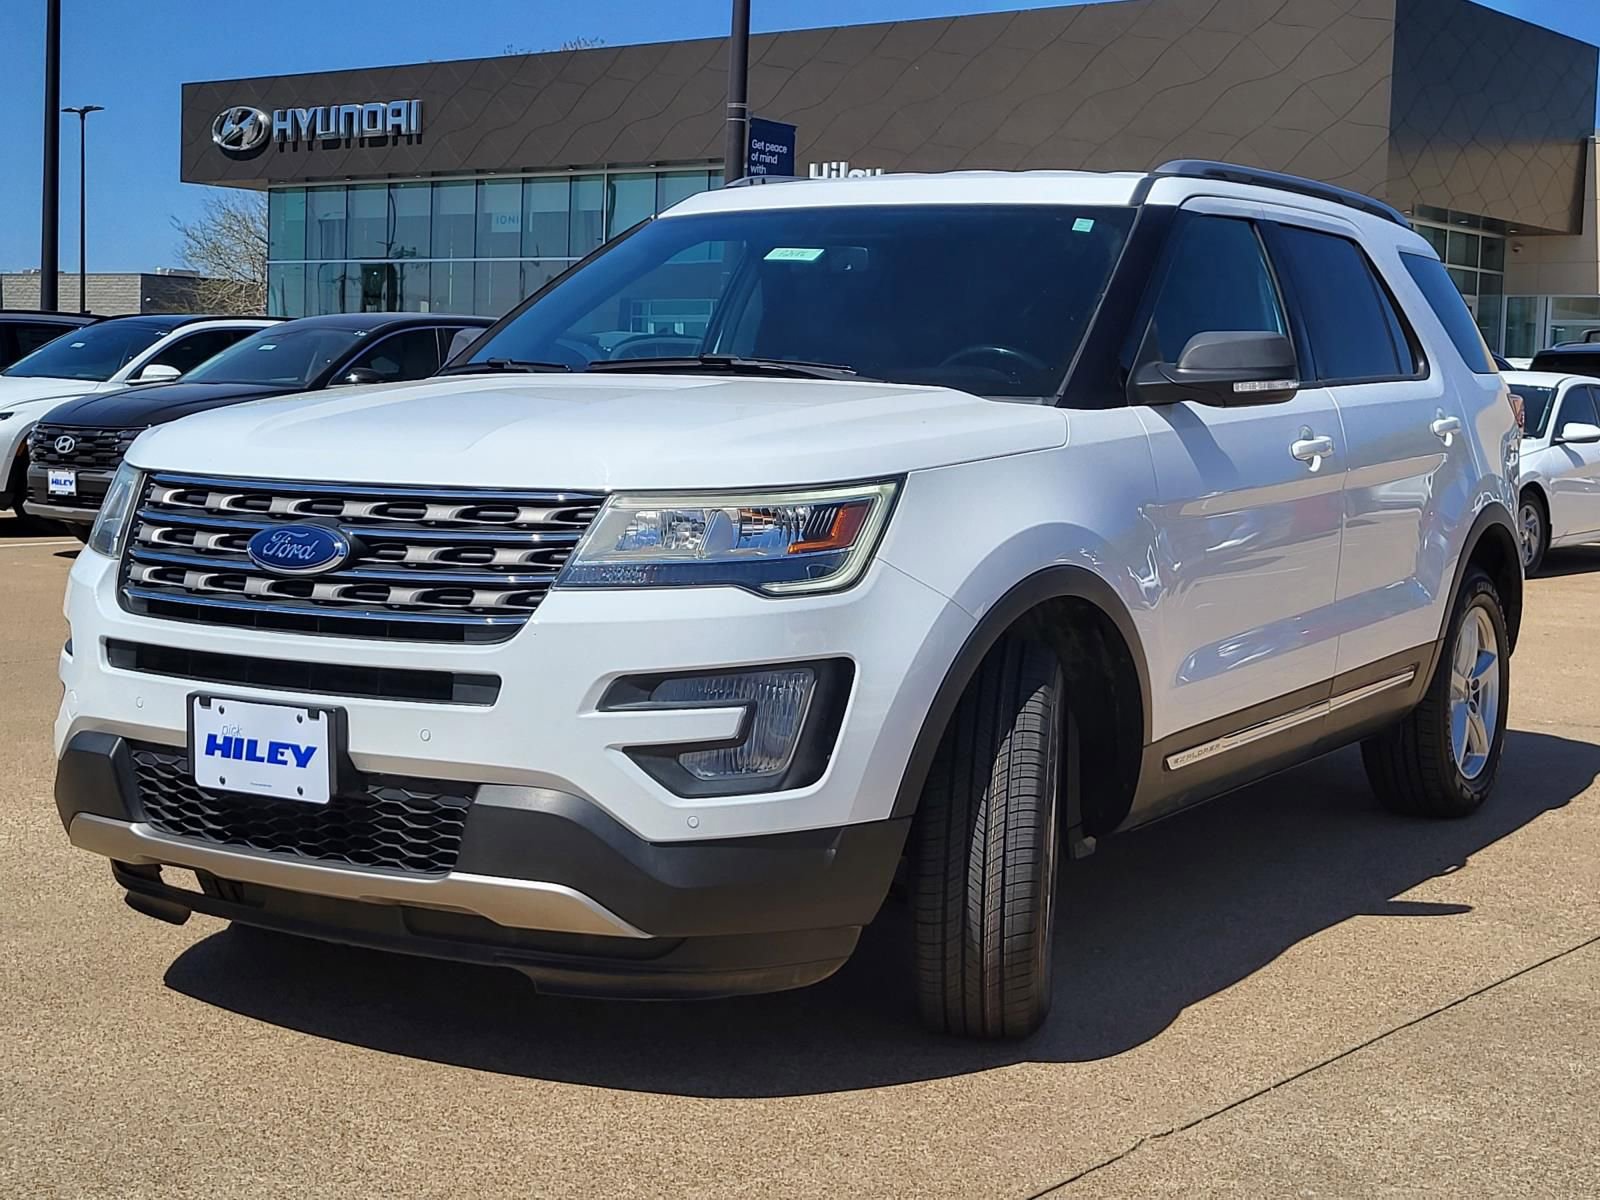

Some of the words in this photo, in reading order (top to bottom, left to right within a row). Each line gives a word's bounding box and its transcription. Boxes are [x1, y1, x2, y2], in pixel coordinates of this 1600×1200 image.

[272, 100, 423, 142] HYUNDAI
[751, 139, 765, 150] Get
[765, 143, 788, 154] peace
[751, 151, 759, 161] of
[760, 153, 778, 164] mind
[750, 164, 767, 174] with
[262, 530, 320, 560] Ford
[204, 733, 318, 769] HILEY
